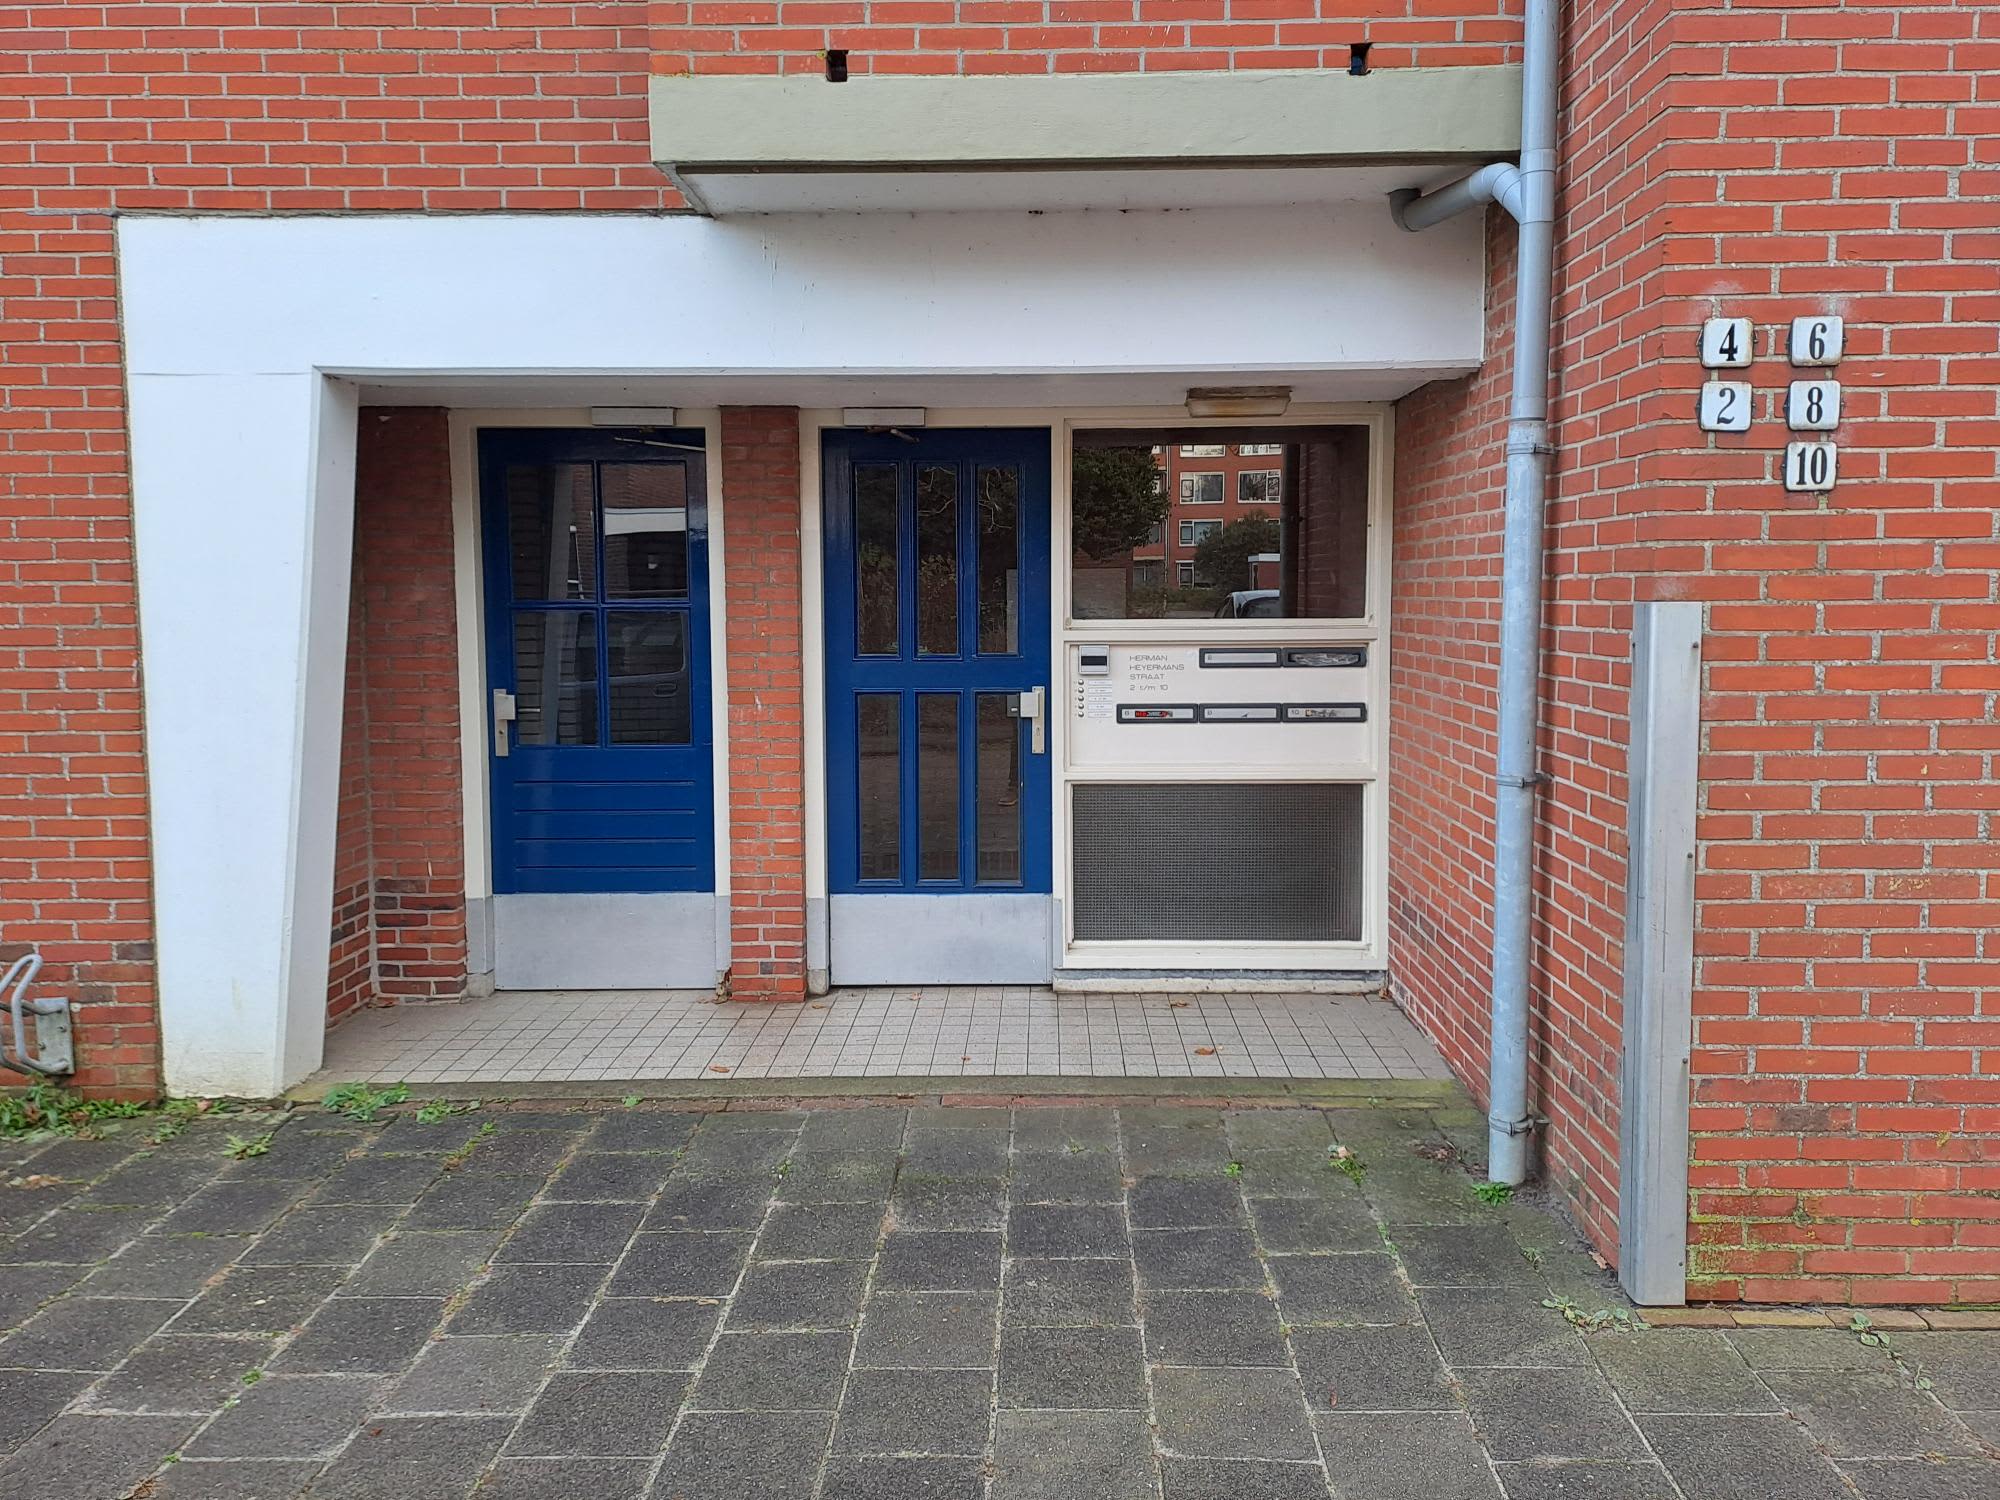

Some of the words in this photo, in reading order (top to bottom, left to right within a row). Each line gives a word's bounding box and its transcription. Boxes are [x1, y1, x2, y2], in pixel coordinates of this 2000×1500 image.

[1719, 323, 1738, 361] 4
[1809, 322, 1827, 360] 6
[1717, 387, 1736, 424] 2
[1806, 386, 1823, 424] 8
[1796, 447, 1828, 485] 10
[1129, 663, 1185, 671] HEYERMANS
